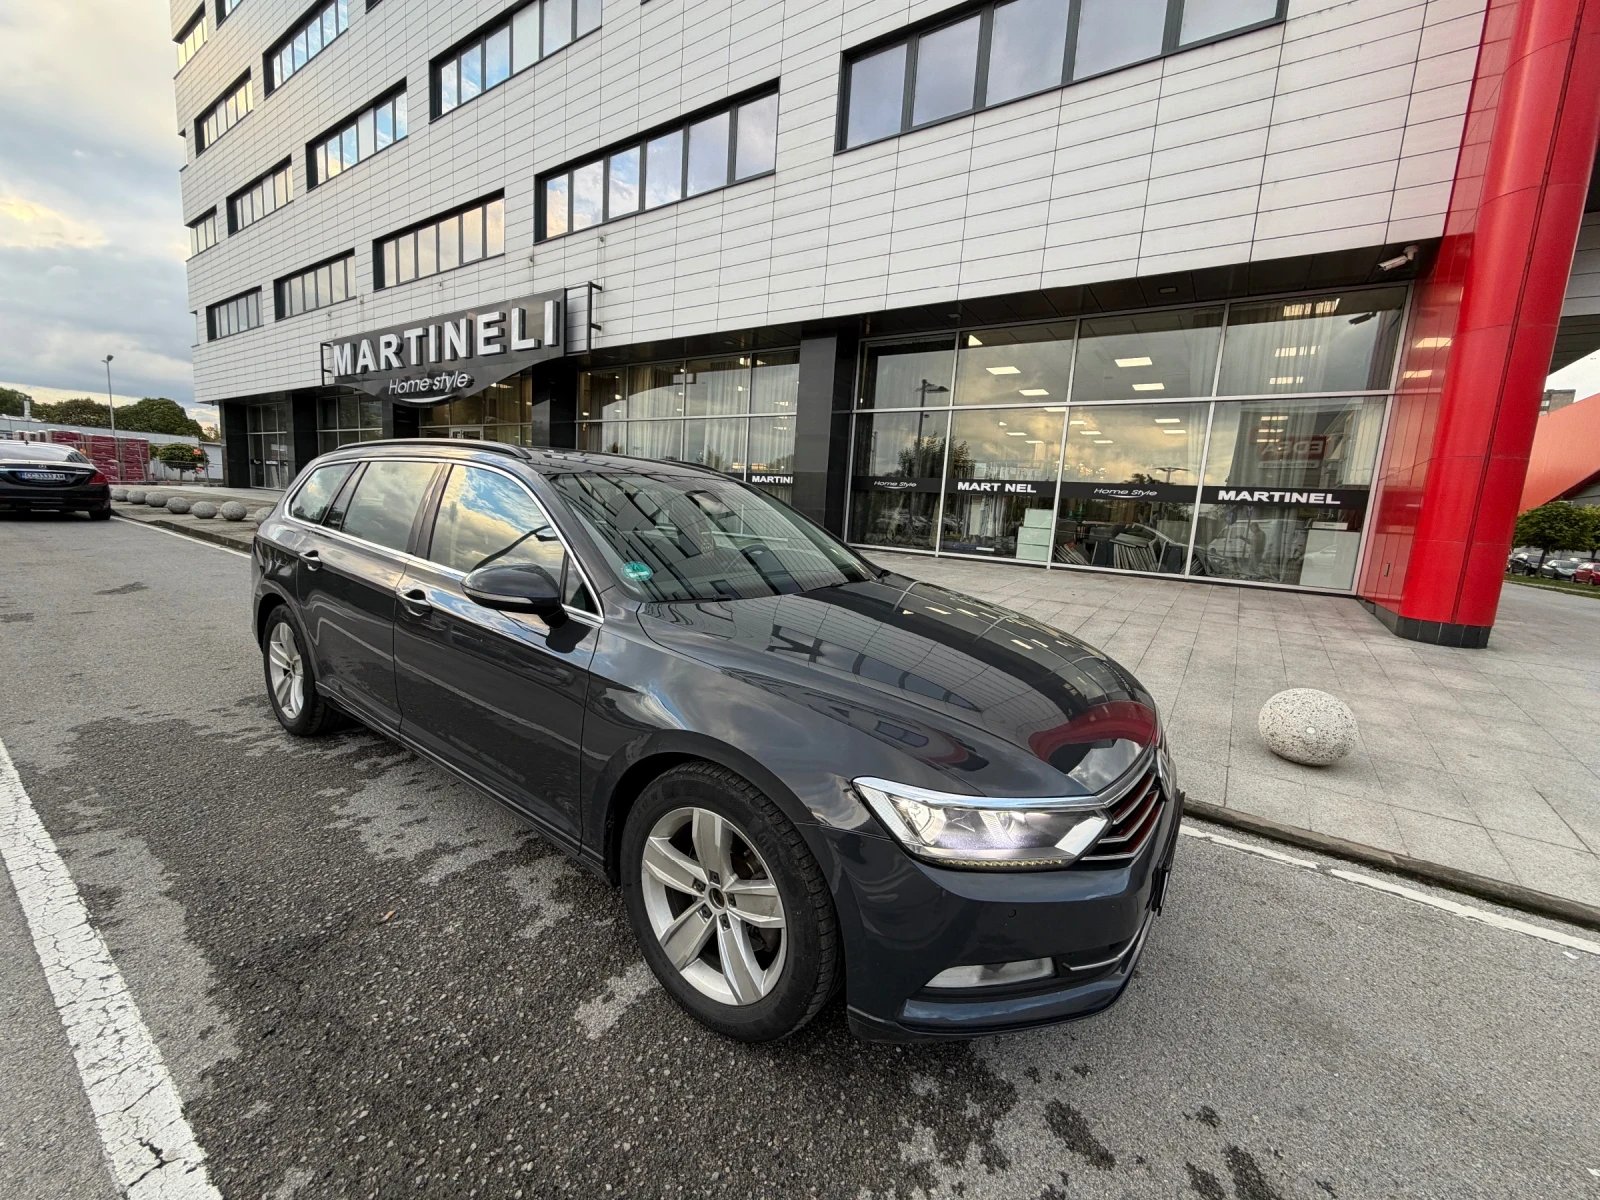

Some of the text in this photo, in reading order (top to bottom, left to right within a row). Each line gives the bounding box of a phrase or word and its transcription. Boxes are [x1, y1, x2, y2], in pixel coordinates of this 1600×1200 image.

[333, 300, 561, 377] MARTINELI
[388, 370, 469, 395] Home style
[1131, 489, 1158, 497] Style
[1218, 490, 1341, 505] MARTINEL
